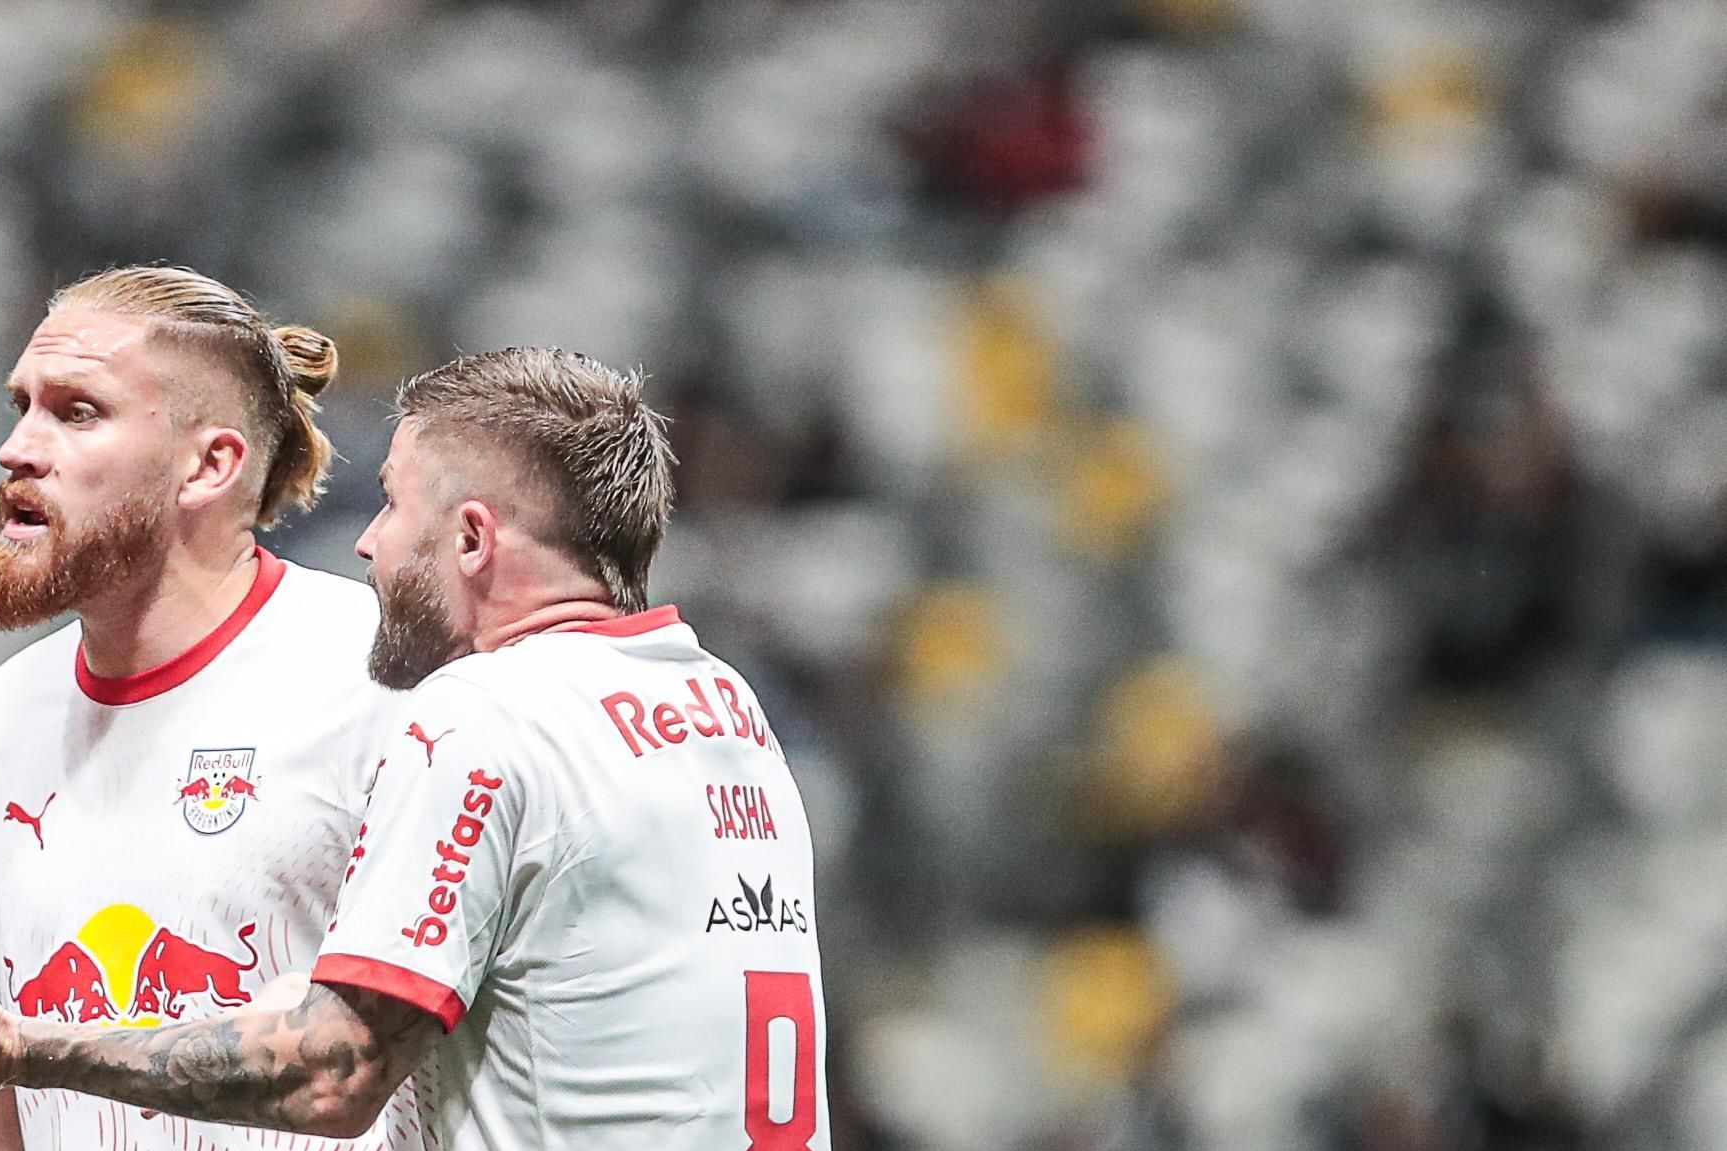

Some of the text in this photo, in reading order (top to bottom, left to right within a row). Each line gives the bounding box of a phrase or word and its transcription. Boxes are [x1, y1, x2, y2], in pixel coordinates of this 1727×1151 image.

[600, 678, 725, 758] Red
[223, 753, 251, 769] Bull
[706, 784, 778, 840] SASHA
[401, 768, 503, 947] betfast
